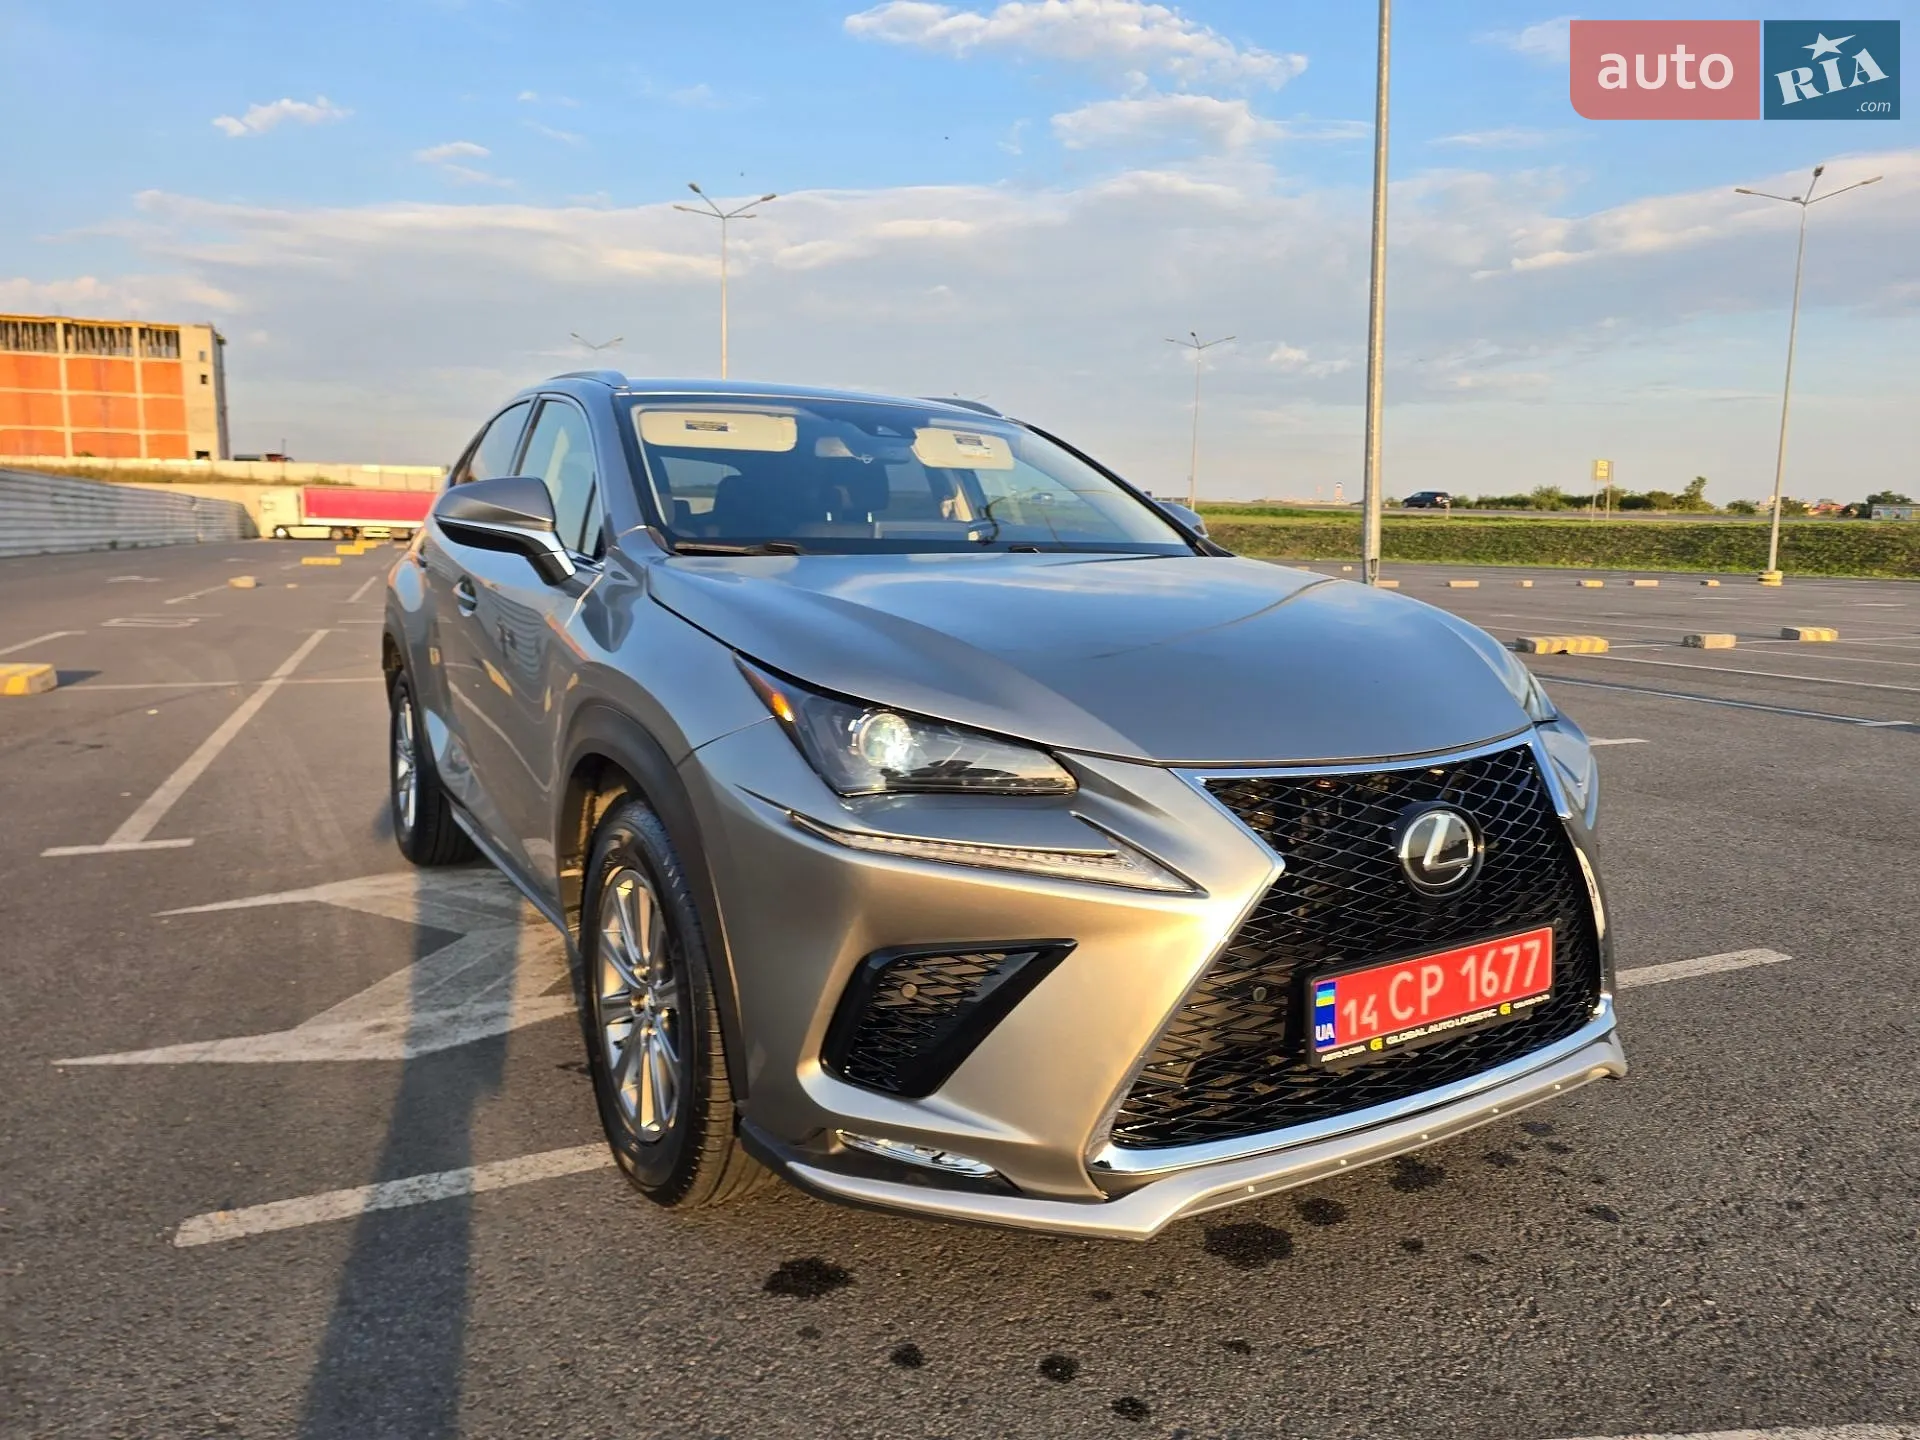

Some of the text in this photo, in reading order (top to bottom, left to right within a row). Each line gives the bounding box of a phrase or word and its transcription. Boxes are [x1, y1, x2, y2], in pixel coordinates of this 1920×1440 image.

[1342, 939, 1541, 1036] 14 CP 1677
[1315, 1023, 1335, 1041] UA
